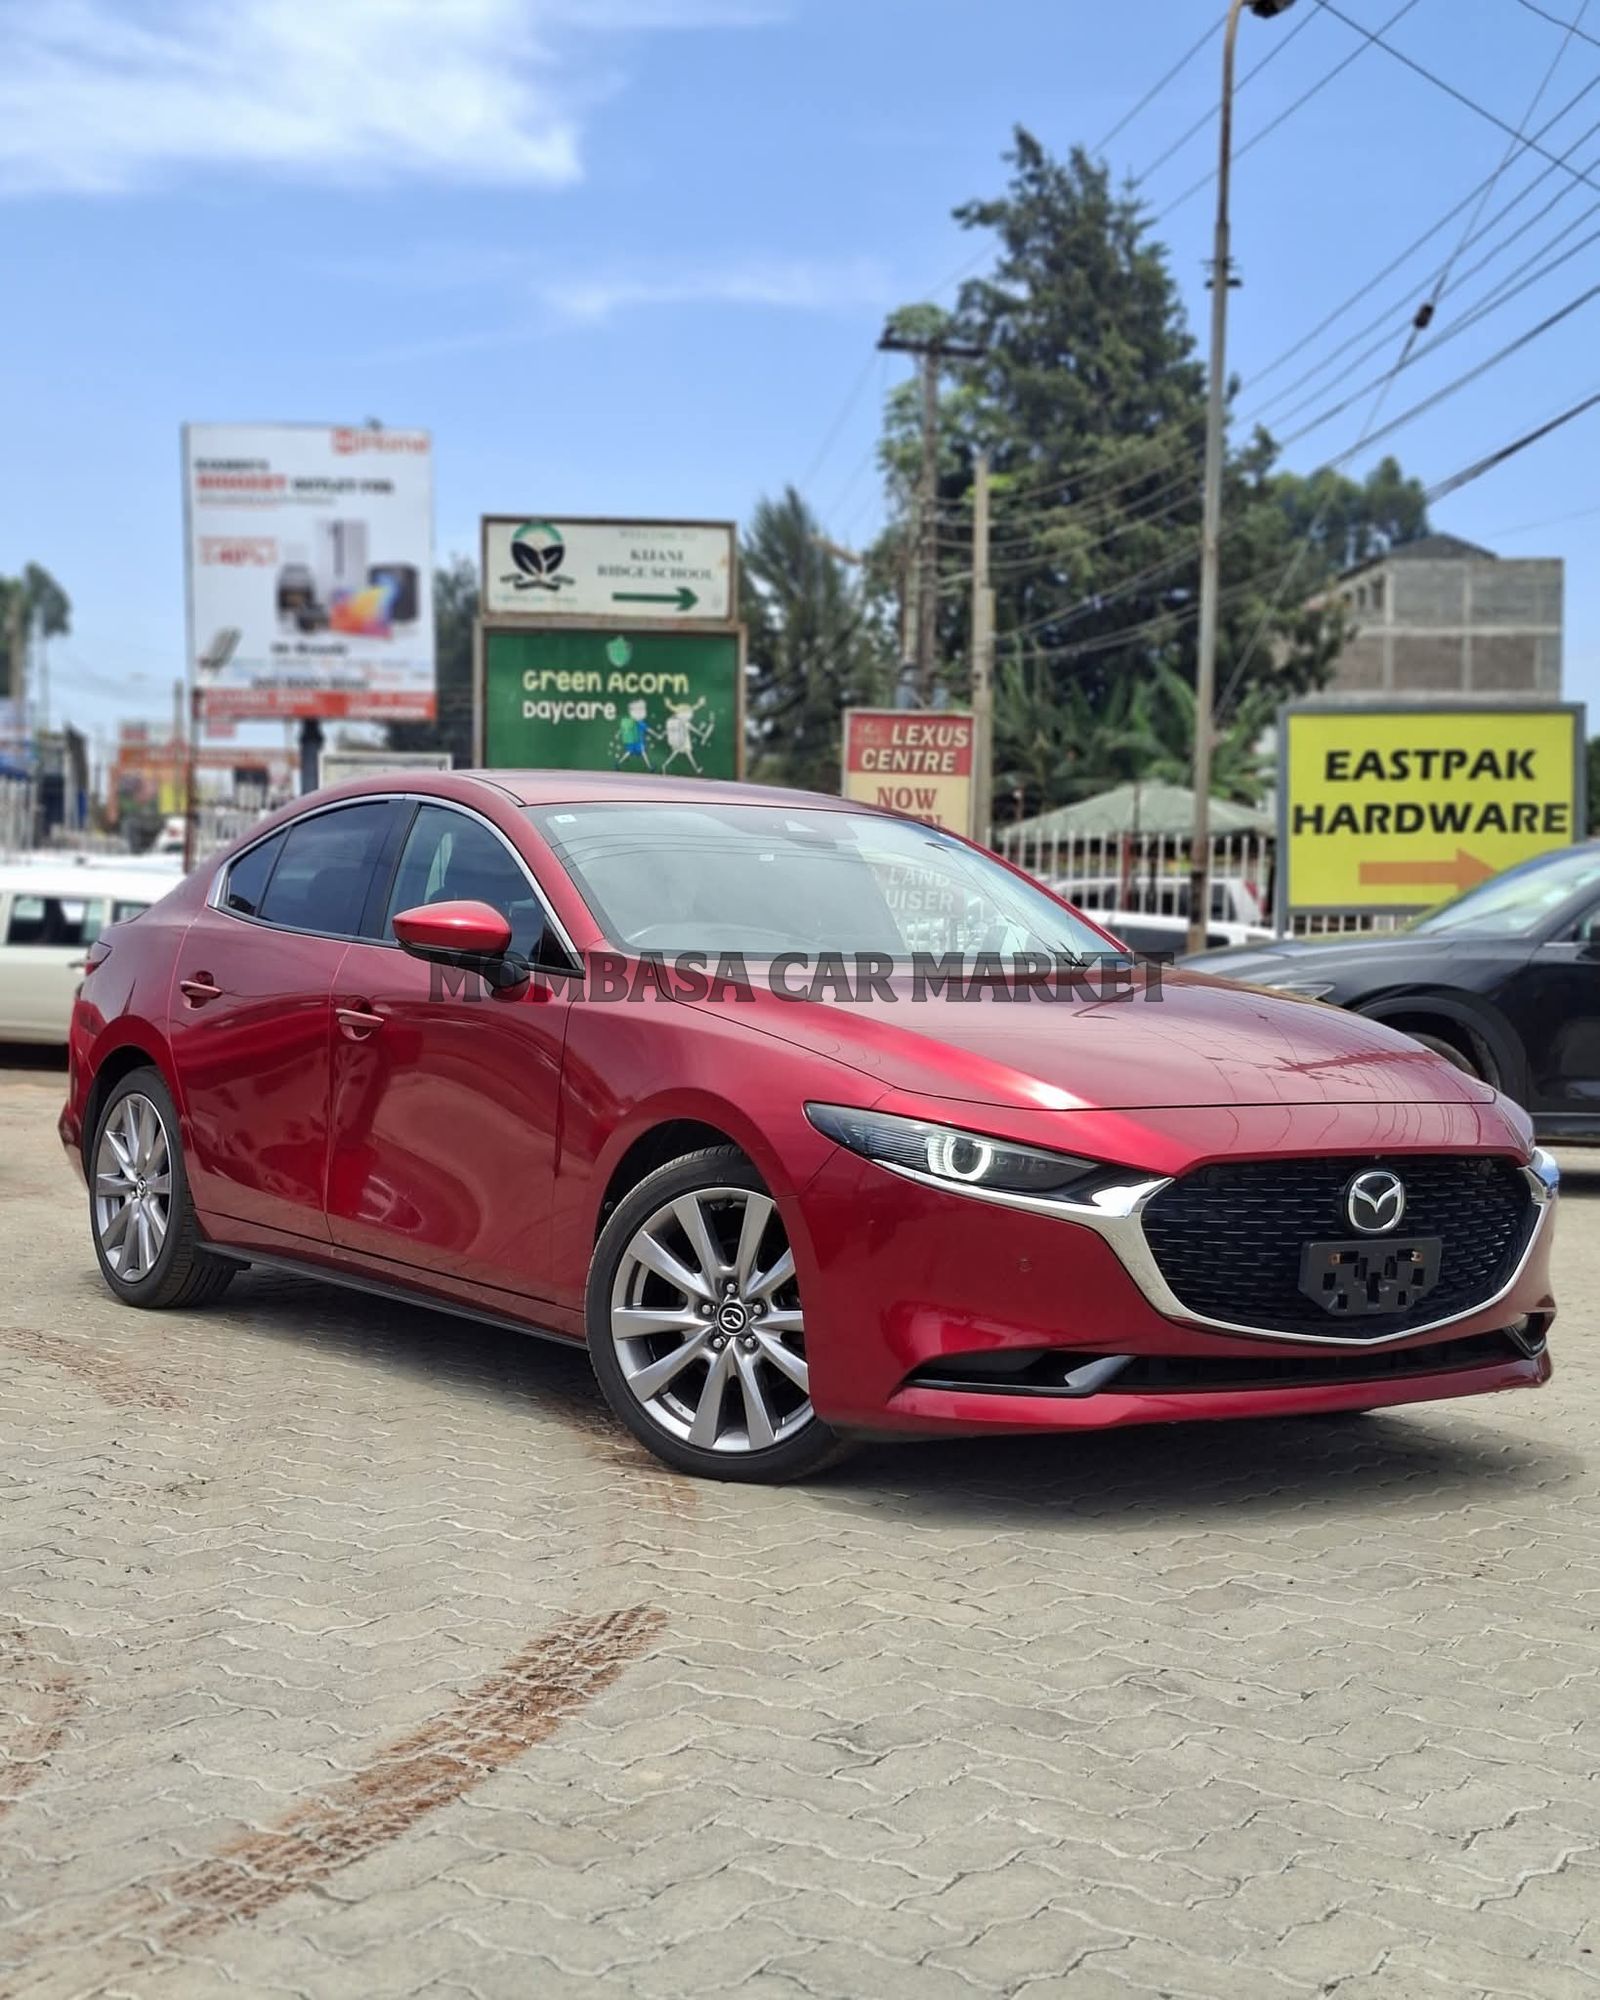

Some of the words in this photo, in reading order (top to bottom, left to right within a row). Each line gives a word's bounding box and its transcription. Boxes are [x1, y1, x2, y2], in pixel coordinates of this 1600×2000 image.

[522, 669, 602, 693] Green
[606, 672, 690, 695] Acorn
[522, 700, 617, 725] Daycare
[891, 723, 970, 748] LEXUS
[861, 747, 957, 773] CENTRE
[1324, 748, 1537, 782] EASTPAK
[876, 786, 938, 811] NOW
[1292, 802, 1569, 835] HARDWARE
[885, 889, 955, 912] UISER
